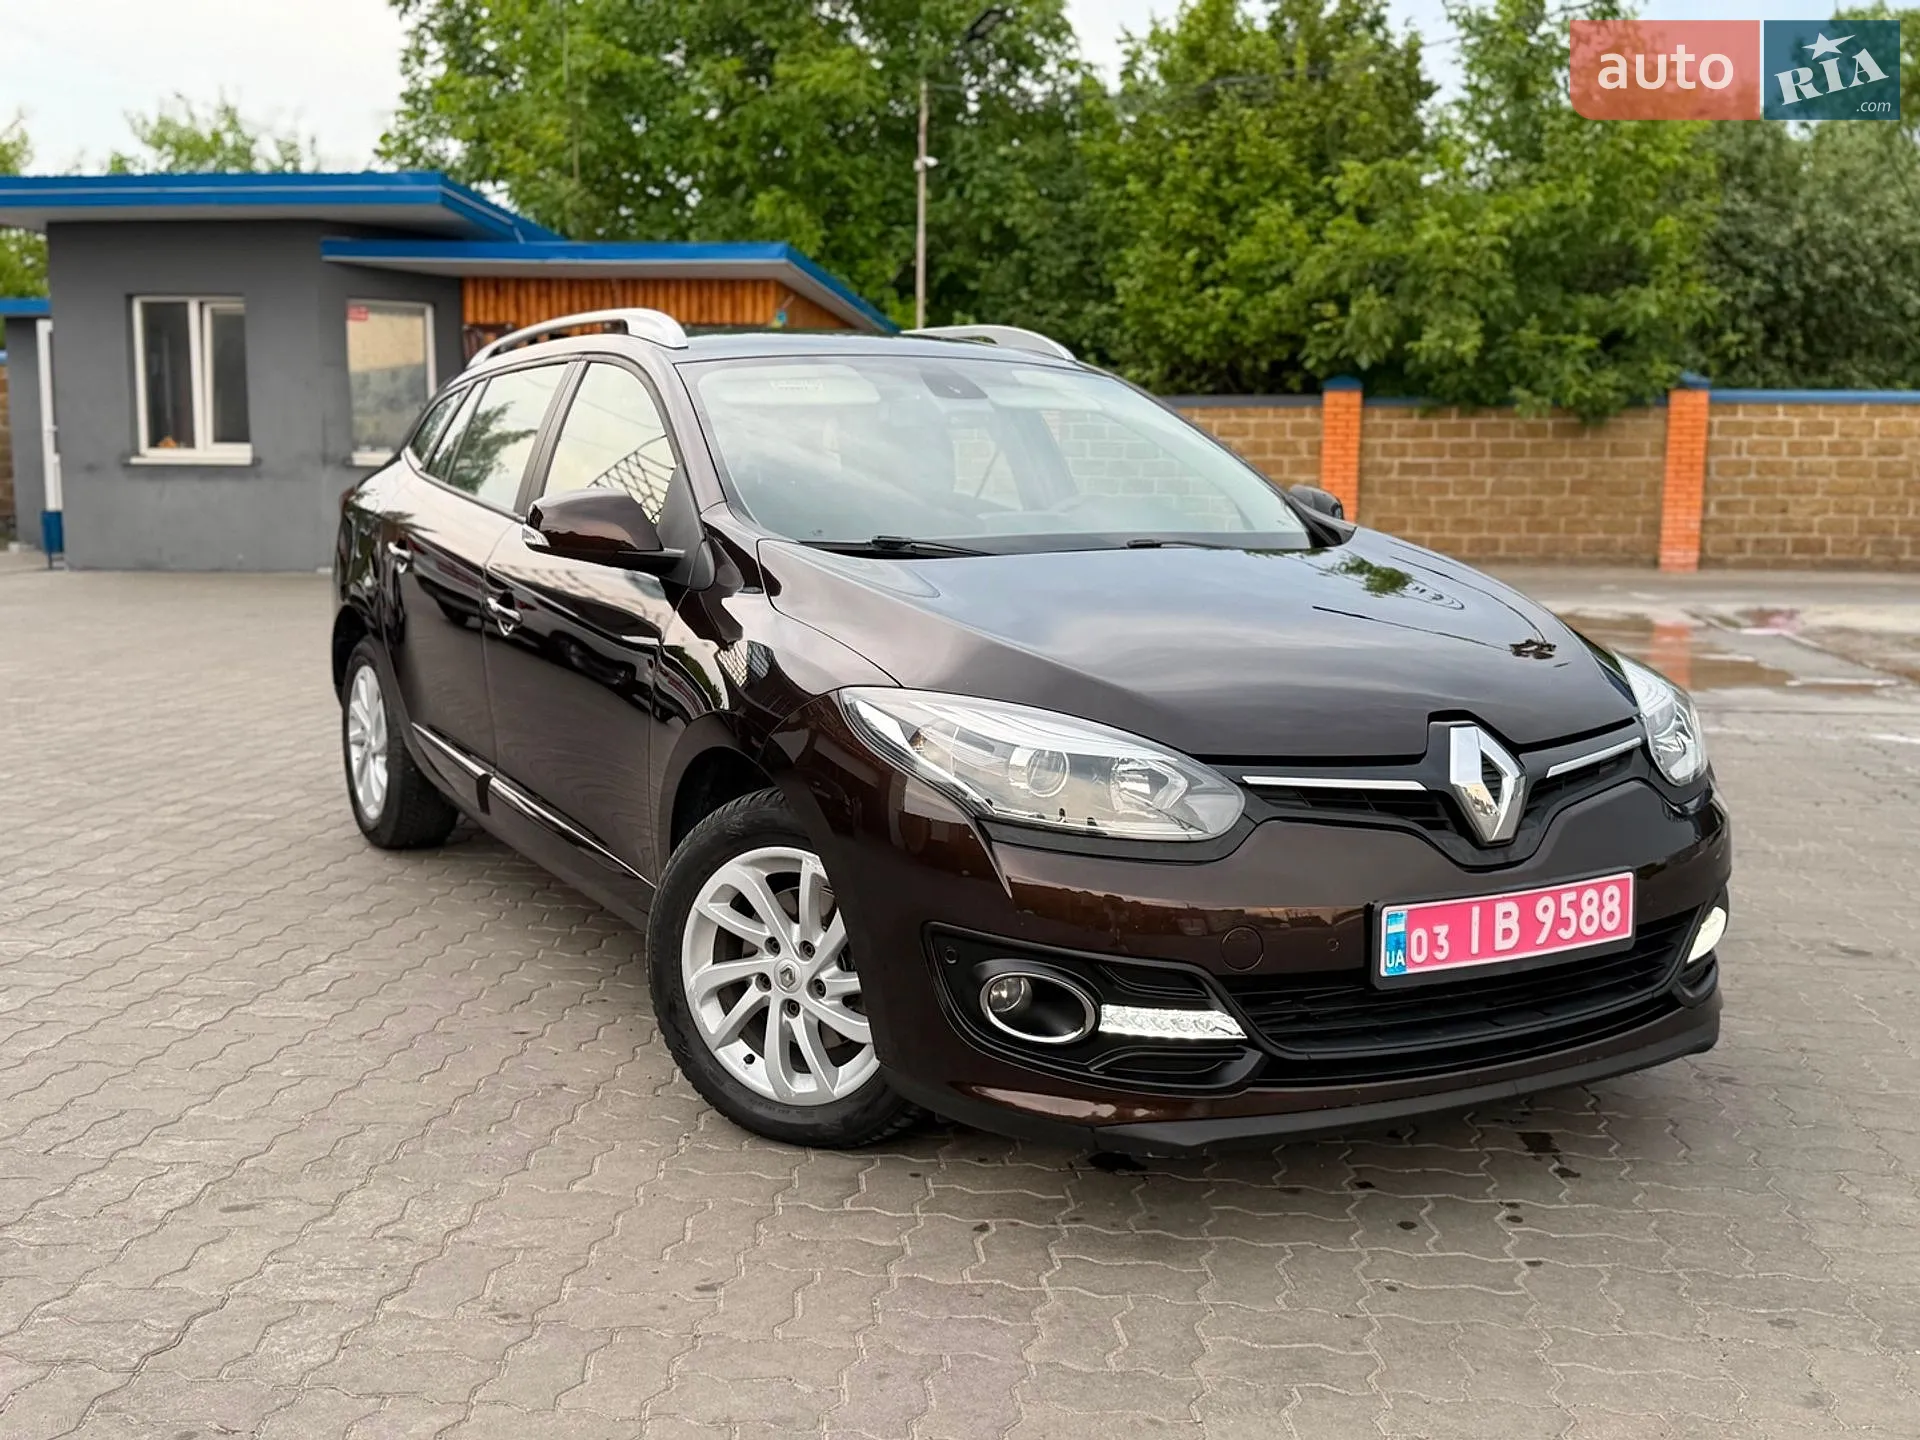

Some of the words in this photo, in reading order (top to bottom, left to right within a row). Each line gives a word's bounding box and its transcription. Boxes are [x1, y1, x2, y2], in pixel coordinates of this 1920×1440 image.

[1410, 924, 1450, 964] 03
[1534, 885, 1621, 946] 9588
[1385, 950, 1405, 968] UA
